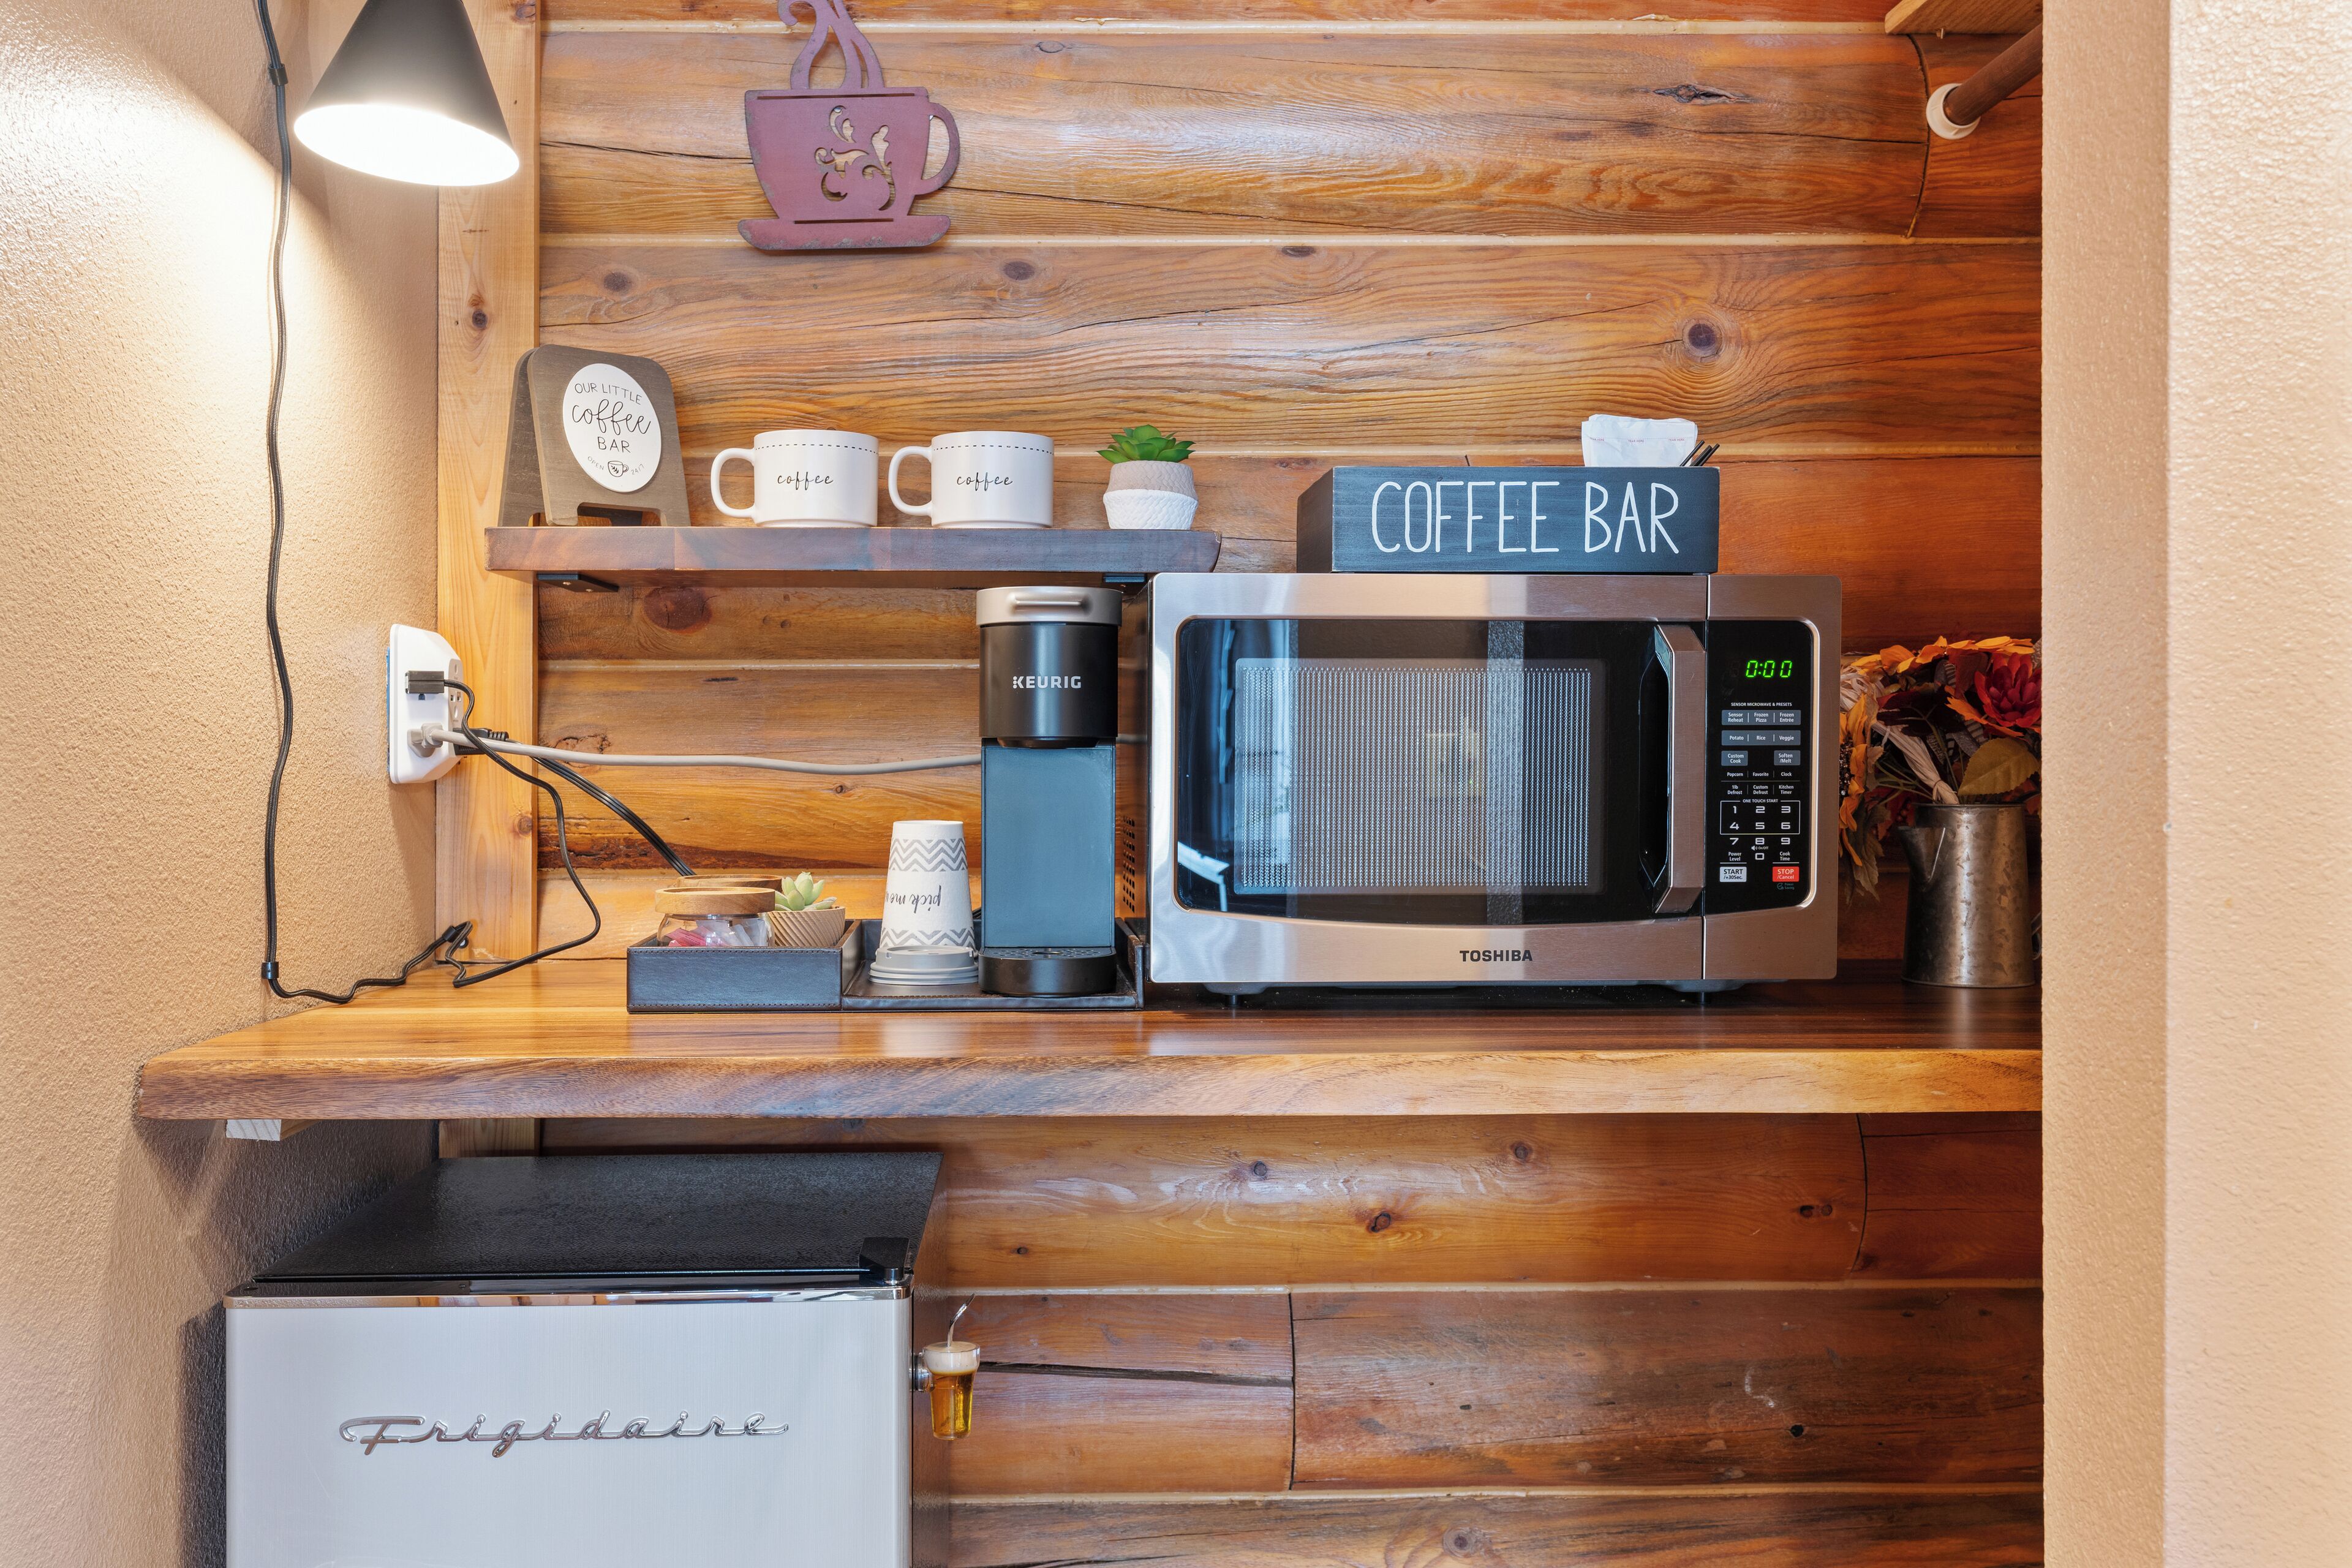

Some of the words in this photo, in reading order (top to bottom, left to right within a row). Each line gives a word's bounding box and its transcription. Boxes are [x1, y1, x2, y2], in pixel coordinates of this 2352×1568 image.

[575, 383, 597, 394] OUR
[601, 383, 642, 405] LITTLE
[572, 399, 651, 435] coffee
[597, 436, 631, 453] BAR
[587, 456, 605, 470] OPEN
[631, 463, 645, 475] 24/7
[777, 471, 834, 491] coffee
[956, 472, 1014, 491] coffee
[1371, 481, 1560, 553] COFFEE
[1585, 481, 1679, 553] BAR
[1746, 660, 1792, 678] 0:00
[1012, 676, 1082, 689] KEURIG
[1733, 805, 1737, 814] 1
[891, 894, 906, 905] me
[909, 885, 941, 913] pick
[1460, 950, 1532, 962] TOSHIBA
[339, 1409, 789, 1458] Frigidaire
